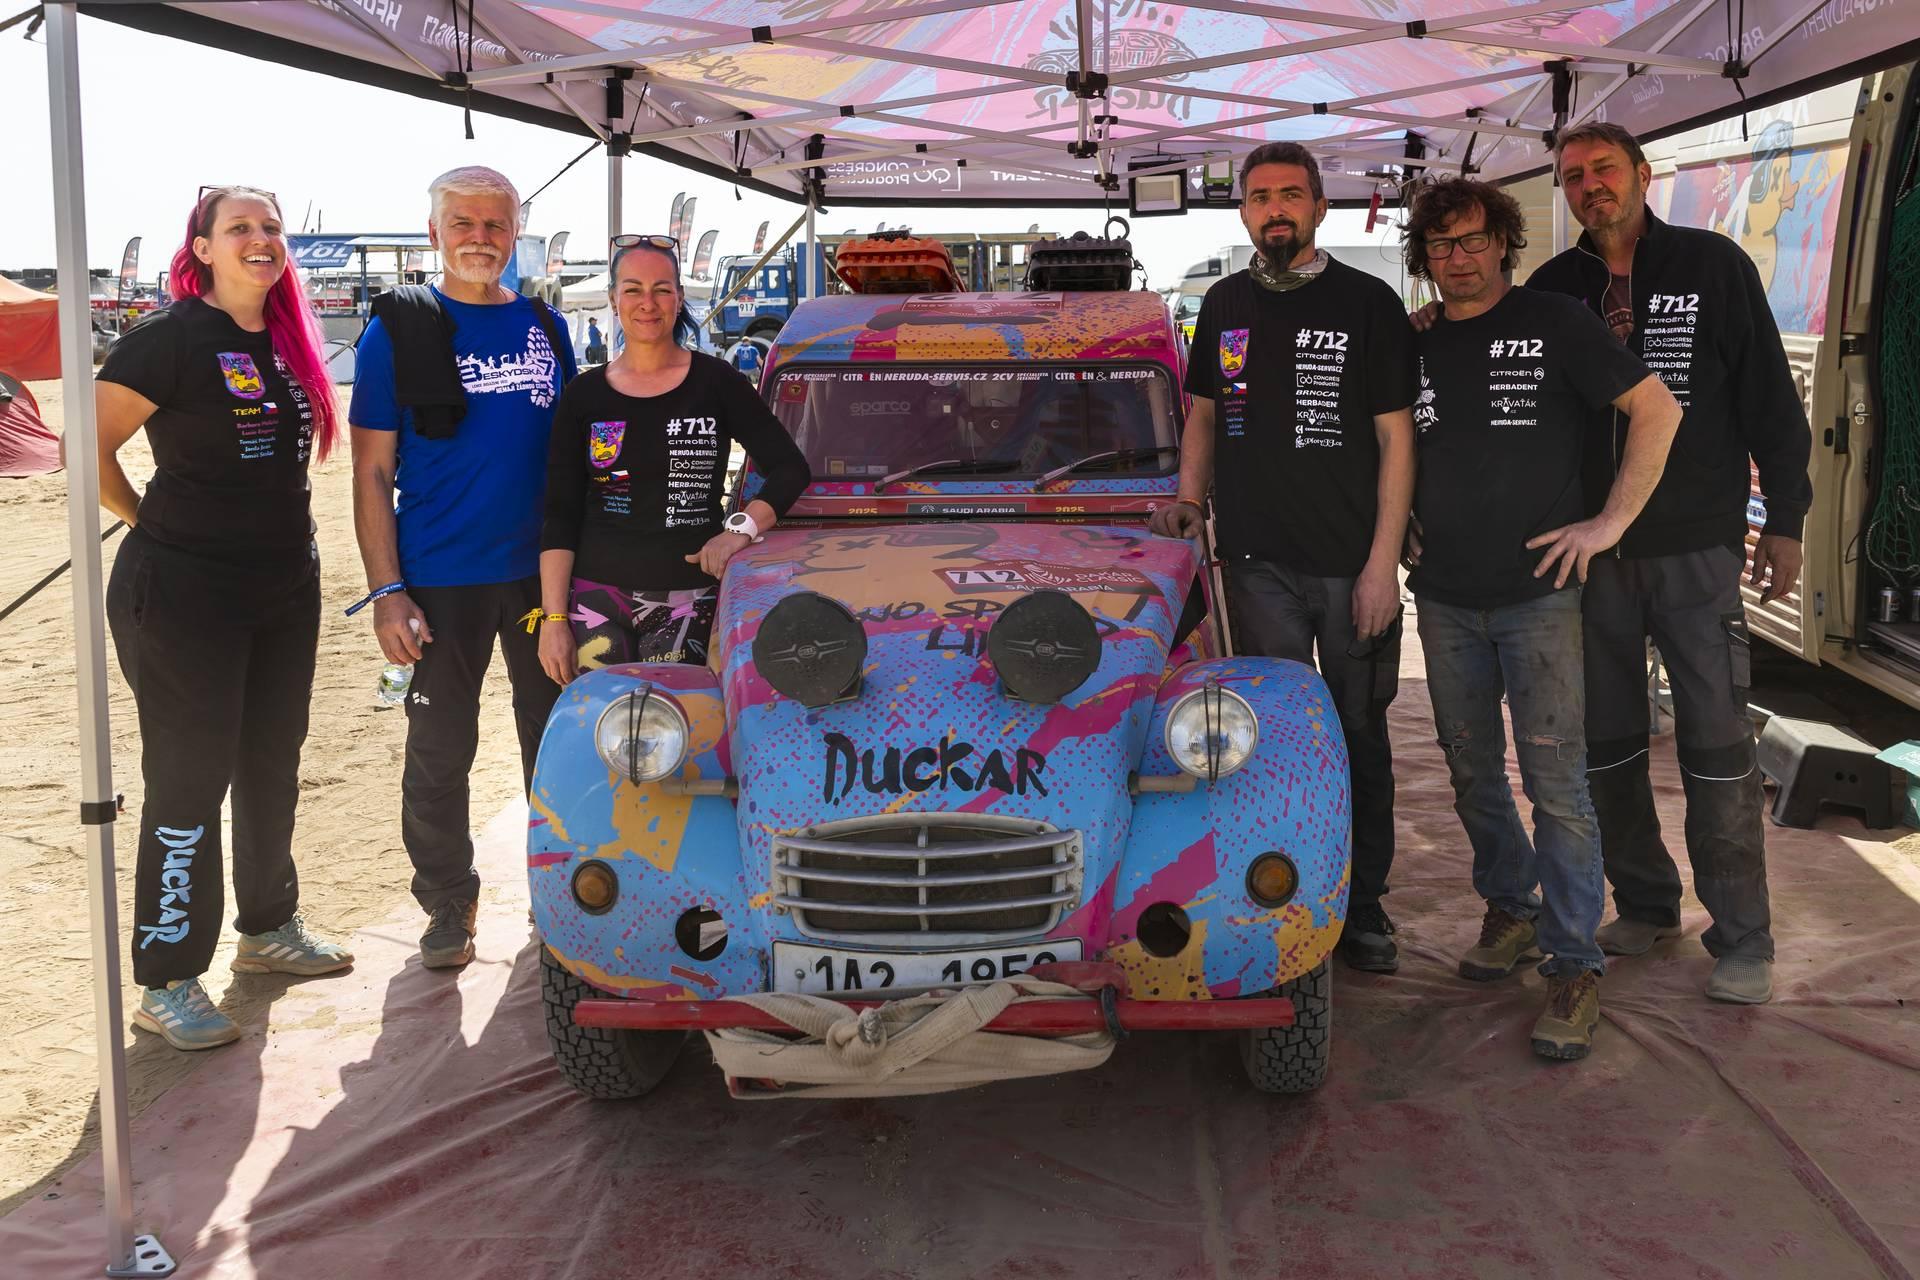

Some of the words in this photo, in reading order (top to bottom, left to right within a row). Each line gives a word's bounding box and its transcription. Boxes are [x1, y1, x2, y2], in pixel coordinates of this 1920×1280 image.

[739, 303, 754, 312] 917
[1648, 293, 1700, 314] #712
[1296, 328, 1349, 351] #712
[1489, 339, 1544, 358] #712
[779, 373, 802, 382] 2CV
[883, 373, 988, 382] NERUDA-SERVIS.CZ
[991, 373, 1014, 381] 2CV
[1110, 370, 1156, 380] NERUDA
[232, 407, 261, 416] TEAM
[849, 400, 911, 416] sparco
[666, 417, 717, 436] #712
[668, 472, 713, 480] BRNOCAR
[983, 506, 1016, 514] ARABIA
[1055, 505, 1085, 514] 2025
[949, 570, 1023, 584] 712
